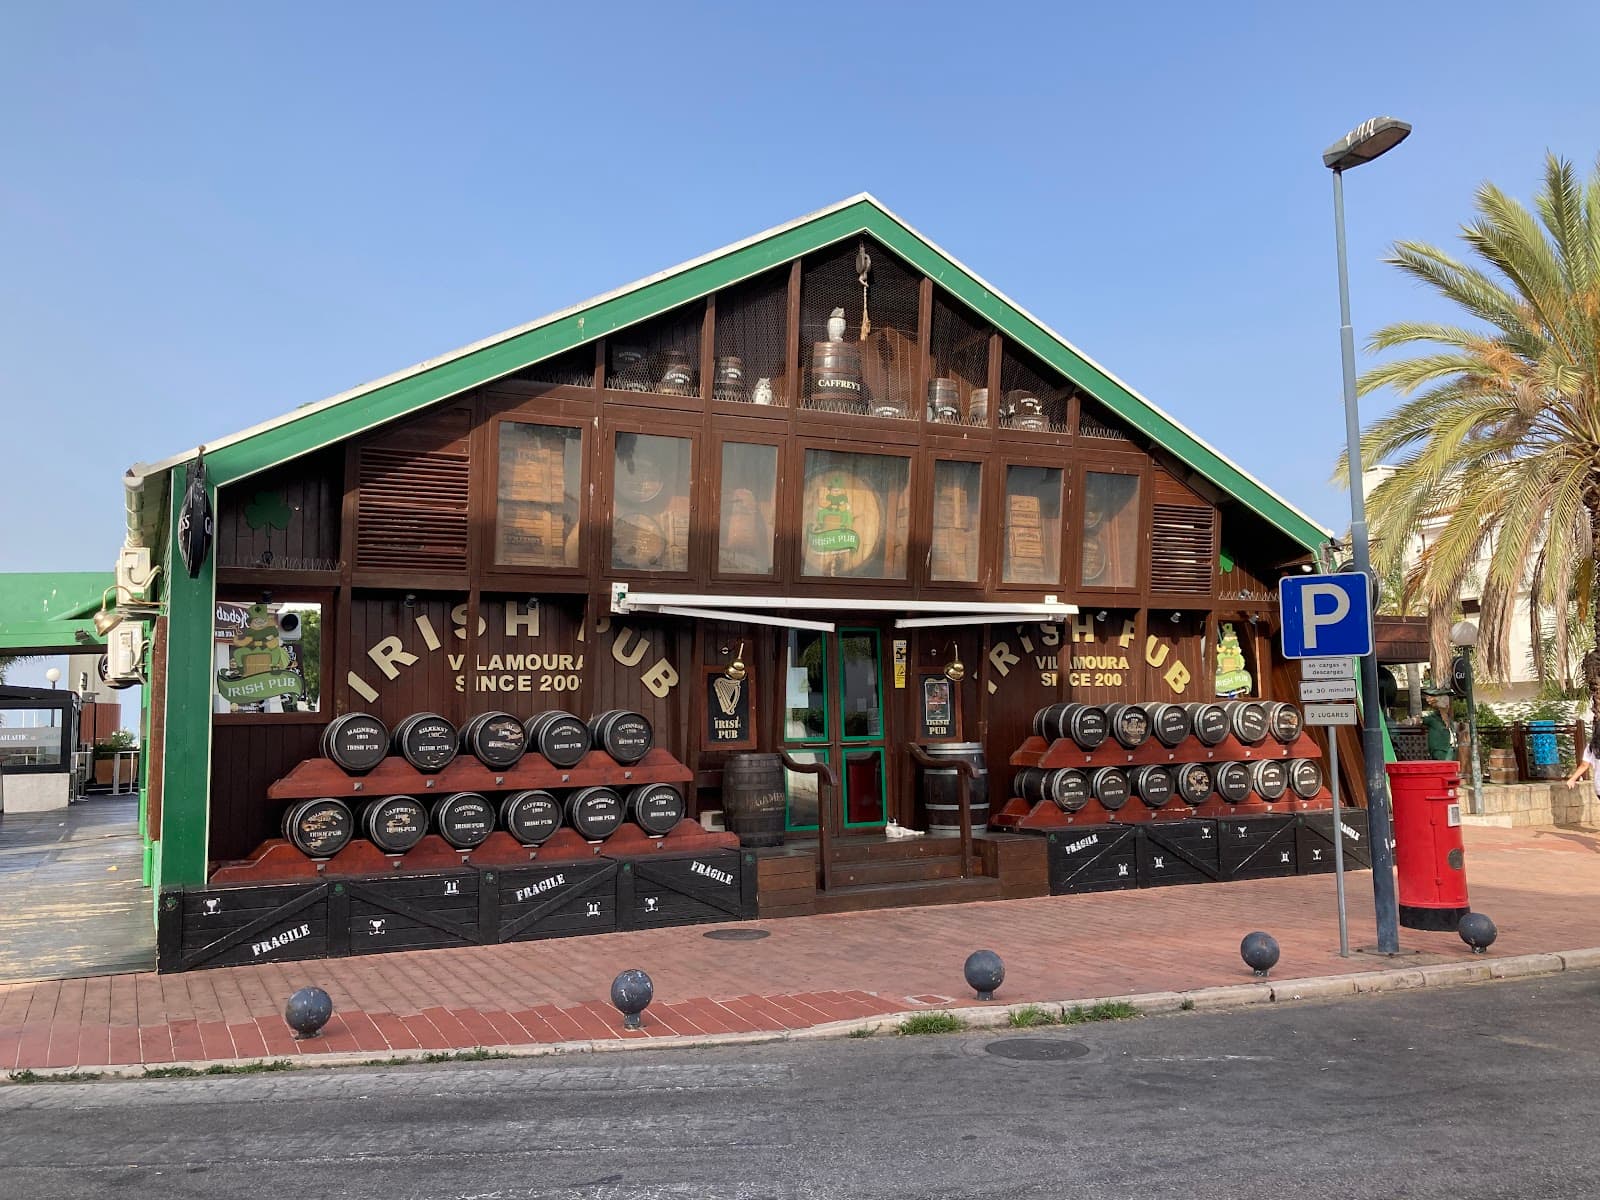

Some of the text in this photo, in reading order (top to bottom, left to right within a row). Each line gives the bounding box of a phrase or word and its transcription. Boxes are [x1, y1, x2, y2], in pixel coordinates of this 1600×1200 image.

[1301, 583, 1350, 649] P
[348, 601, 540, 703] IRISH
[448, 654, 584, 671] VLAMOUR
[1035, 655, 1130, 670] VILMOURA
[228, 677, 296, 697] IRISH PUB
[539, 674, 583, 692] 200
[1041, 672, 1091, 687] SICE
[718, 730, 739, 739] PUB
[929, 727, 947, 735] PUB
[1340, 821, 1360, 841] AGILE
[1065, 833, 1099, 855] FRAGILE
[690, 861, 733, 885] FRAGILE
[516, 873, 566, 902] FRAGILE
[251, 923, 311, 957] FRAGILE
